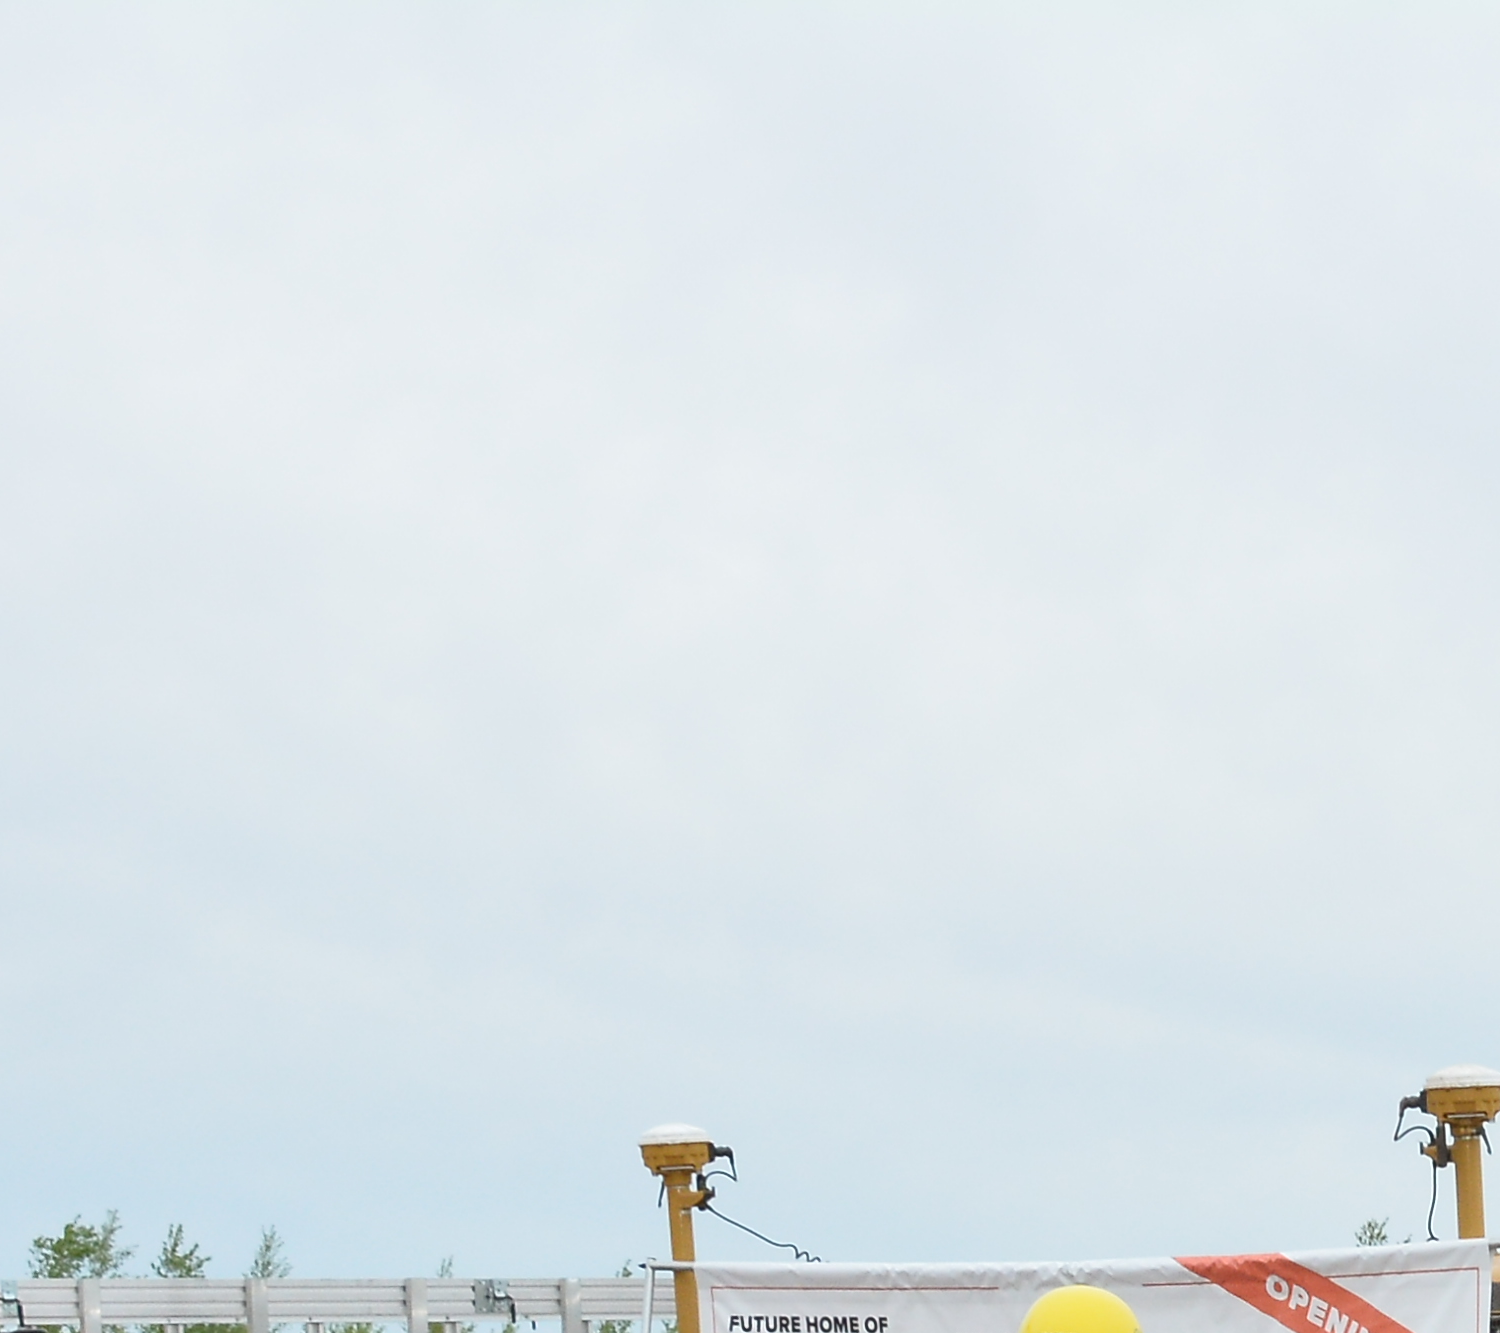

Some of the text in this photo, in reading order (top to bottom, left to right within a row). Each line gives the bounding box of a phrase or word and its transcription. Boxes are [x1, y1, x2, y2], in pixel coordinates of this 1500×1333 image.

[729, 1315, 888, 1333] FUTURE HOME OF
